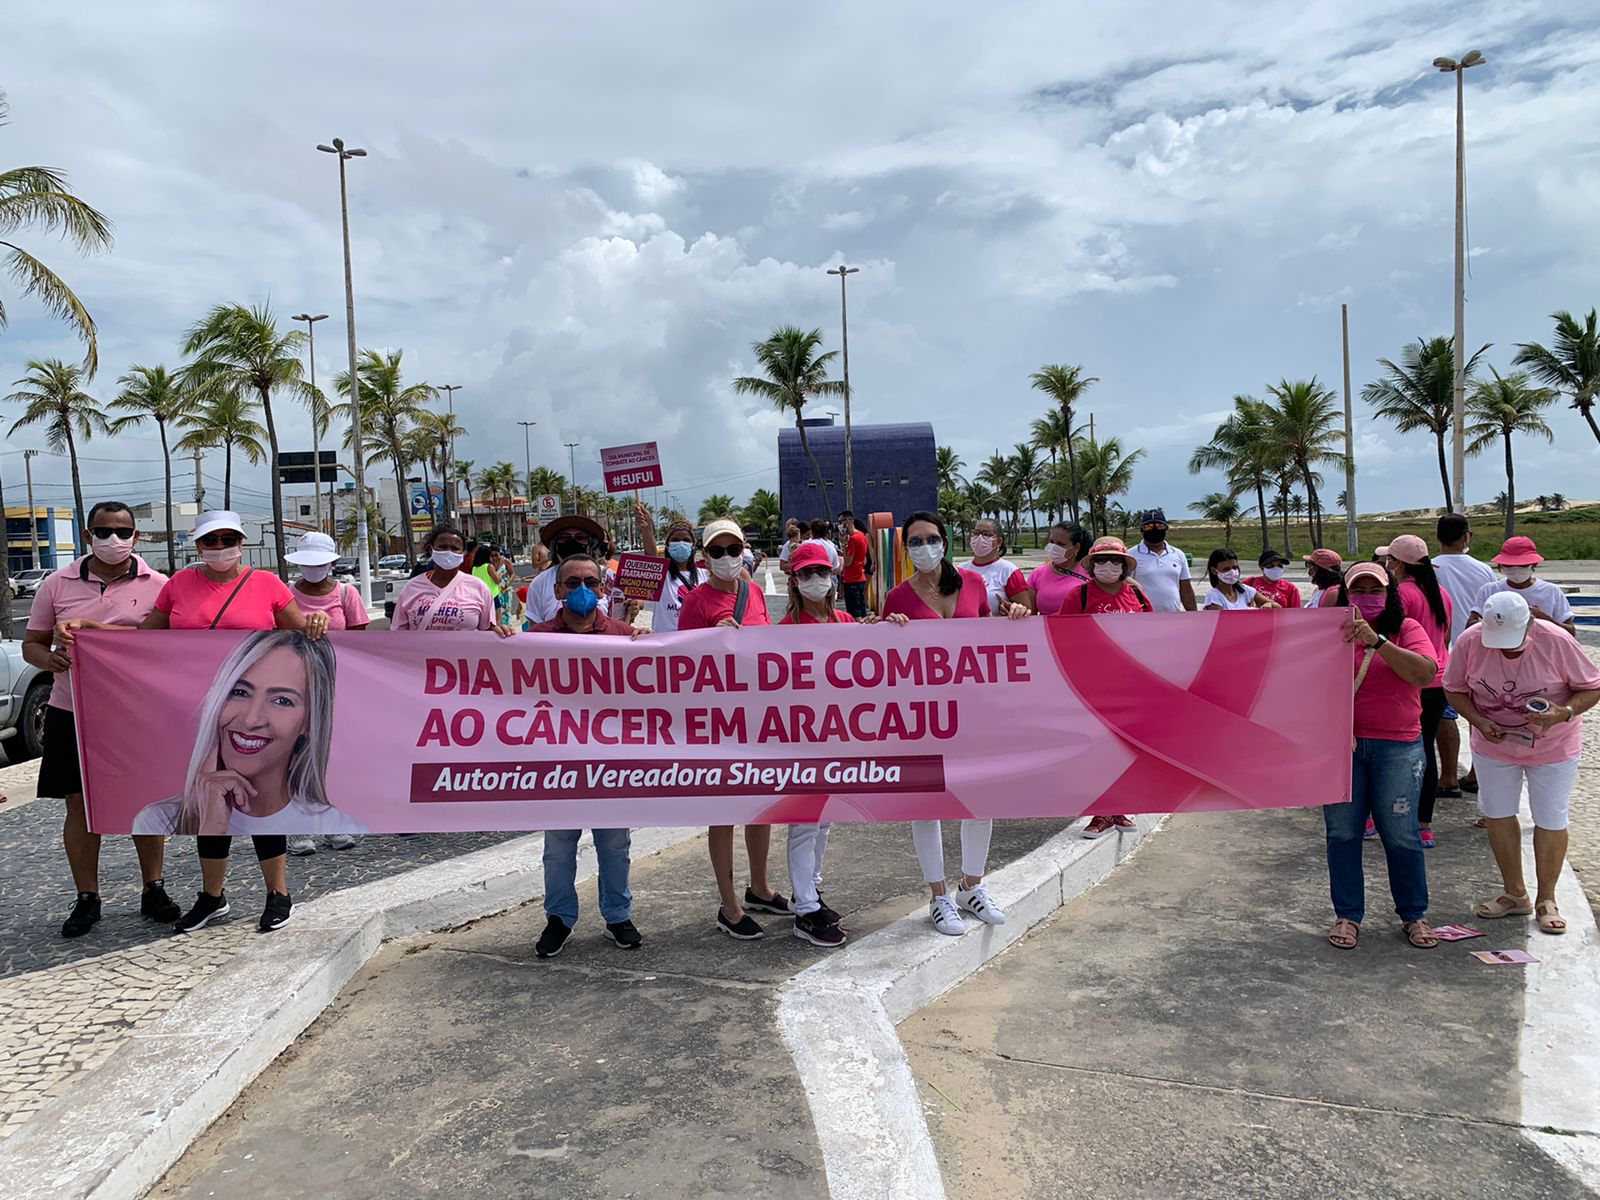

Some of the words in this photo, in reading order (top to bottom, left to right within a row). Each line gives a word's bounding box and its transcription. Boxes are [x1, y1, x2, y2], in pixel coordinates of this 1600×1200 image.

[618, 451, 643, 459] MUNICIPAL
[612, 471, 654, 486] #EUFUI
[625, 560, 662, 571] QUEREMOS
[621, 569, 662, 580] TRATAMENTO
[620, 578, 641, 587] DIGNO
[641, 580, 658, 589] PARA
[627, 587, 648, 597] TODOS
[424, 658, 503, 695] DIA
[511, 654, 748, 695] MUNICIPAL
[757, 652, 815, 692] DE
[825, 644, 1031, 688] COMBATE
[416, 708, 485, 747] AO
[496, 700, 676, 745] CÂNCER
[685, 707, 747, 745] EM
[757, 700, 959, 744] ARACAJU
[432, 766, 536, 791] Autoria
[543, 764, 577, 789] da
[586, 762, 722, 788] Vereadora
[727, 762, 817, 791] Sheyla
[824, 761, 900, 784] Galba
